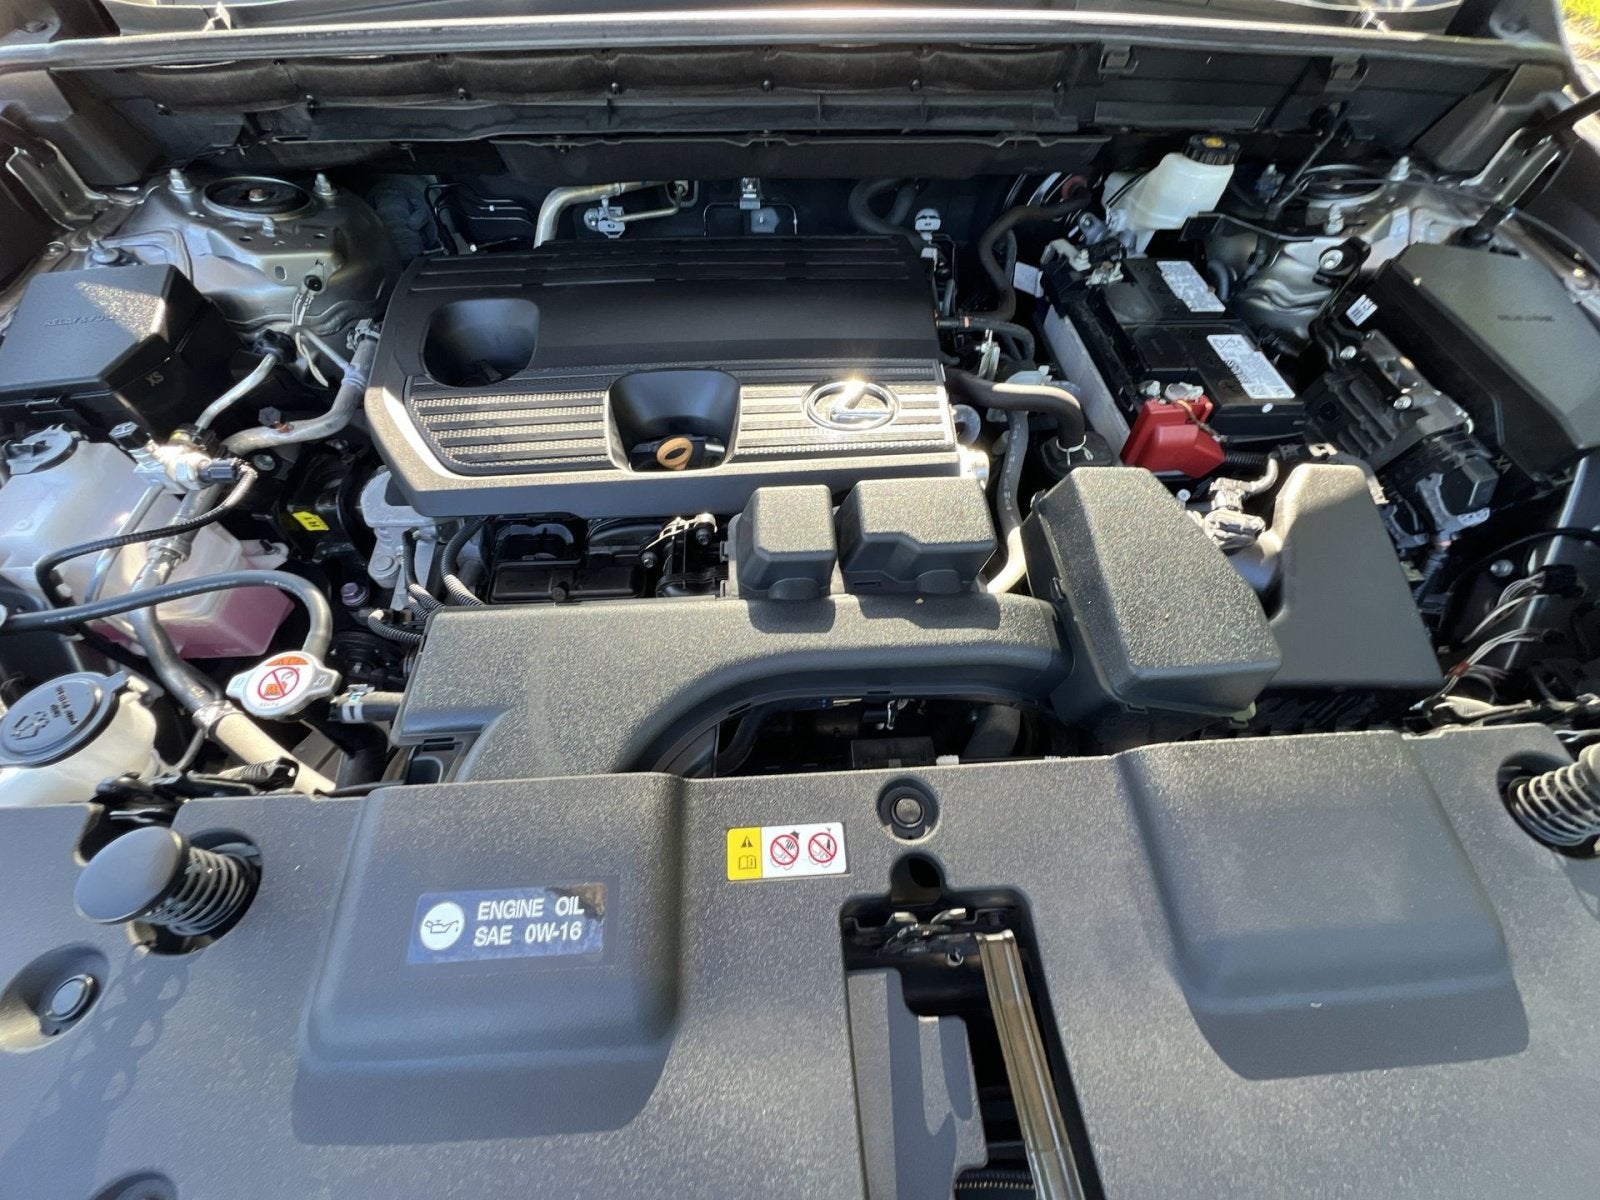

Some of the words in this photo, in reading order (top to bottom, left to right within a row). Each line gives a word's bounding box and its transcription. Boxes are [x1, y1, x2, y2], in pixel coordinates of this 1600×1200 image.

[477, 899, 545, 921] ENGINE
[555, 896, 585, 916] OIL
[473, 925, 513, 947] SAE
[525, 921, 582, 943] 0W-16
